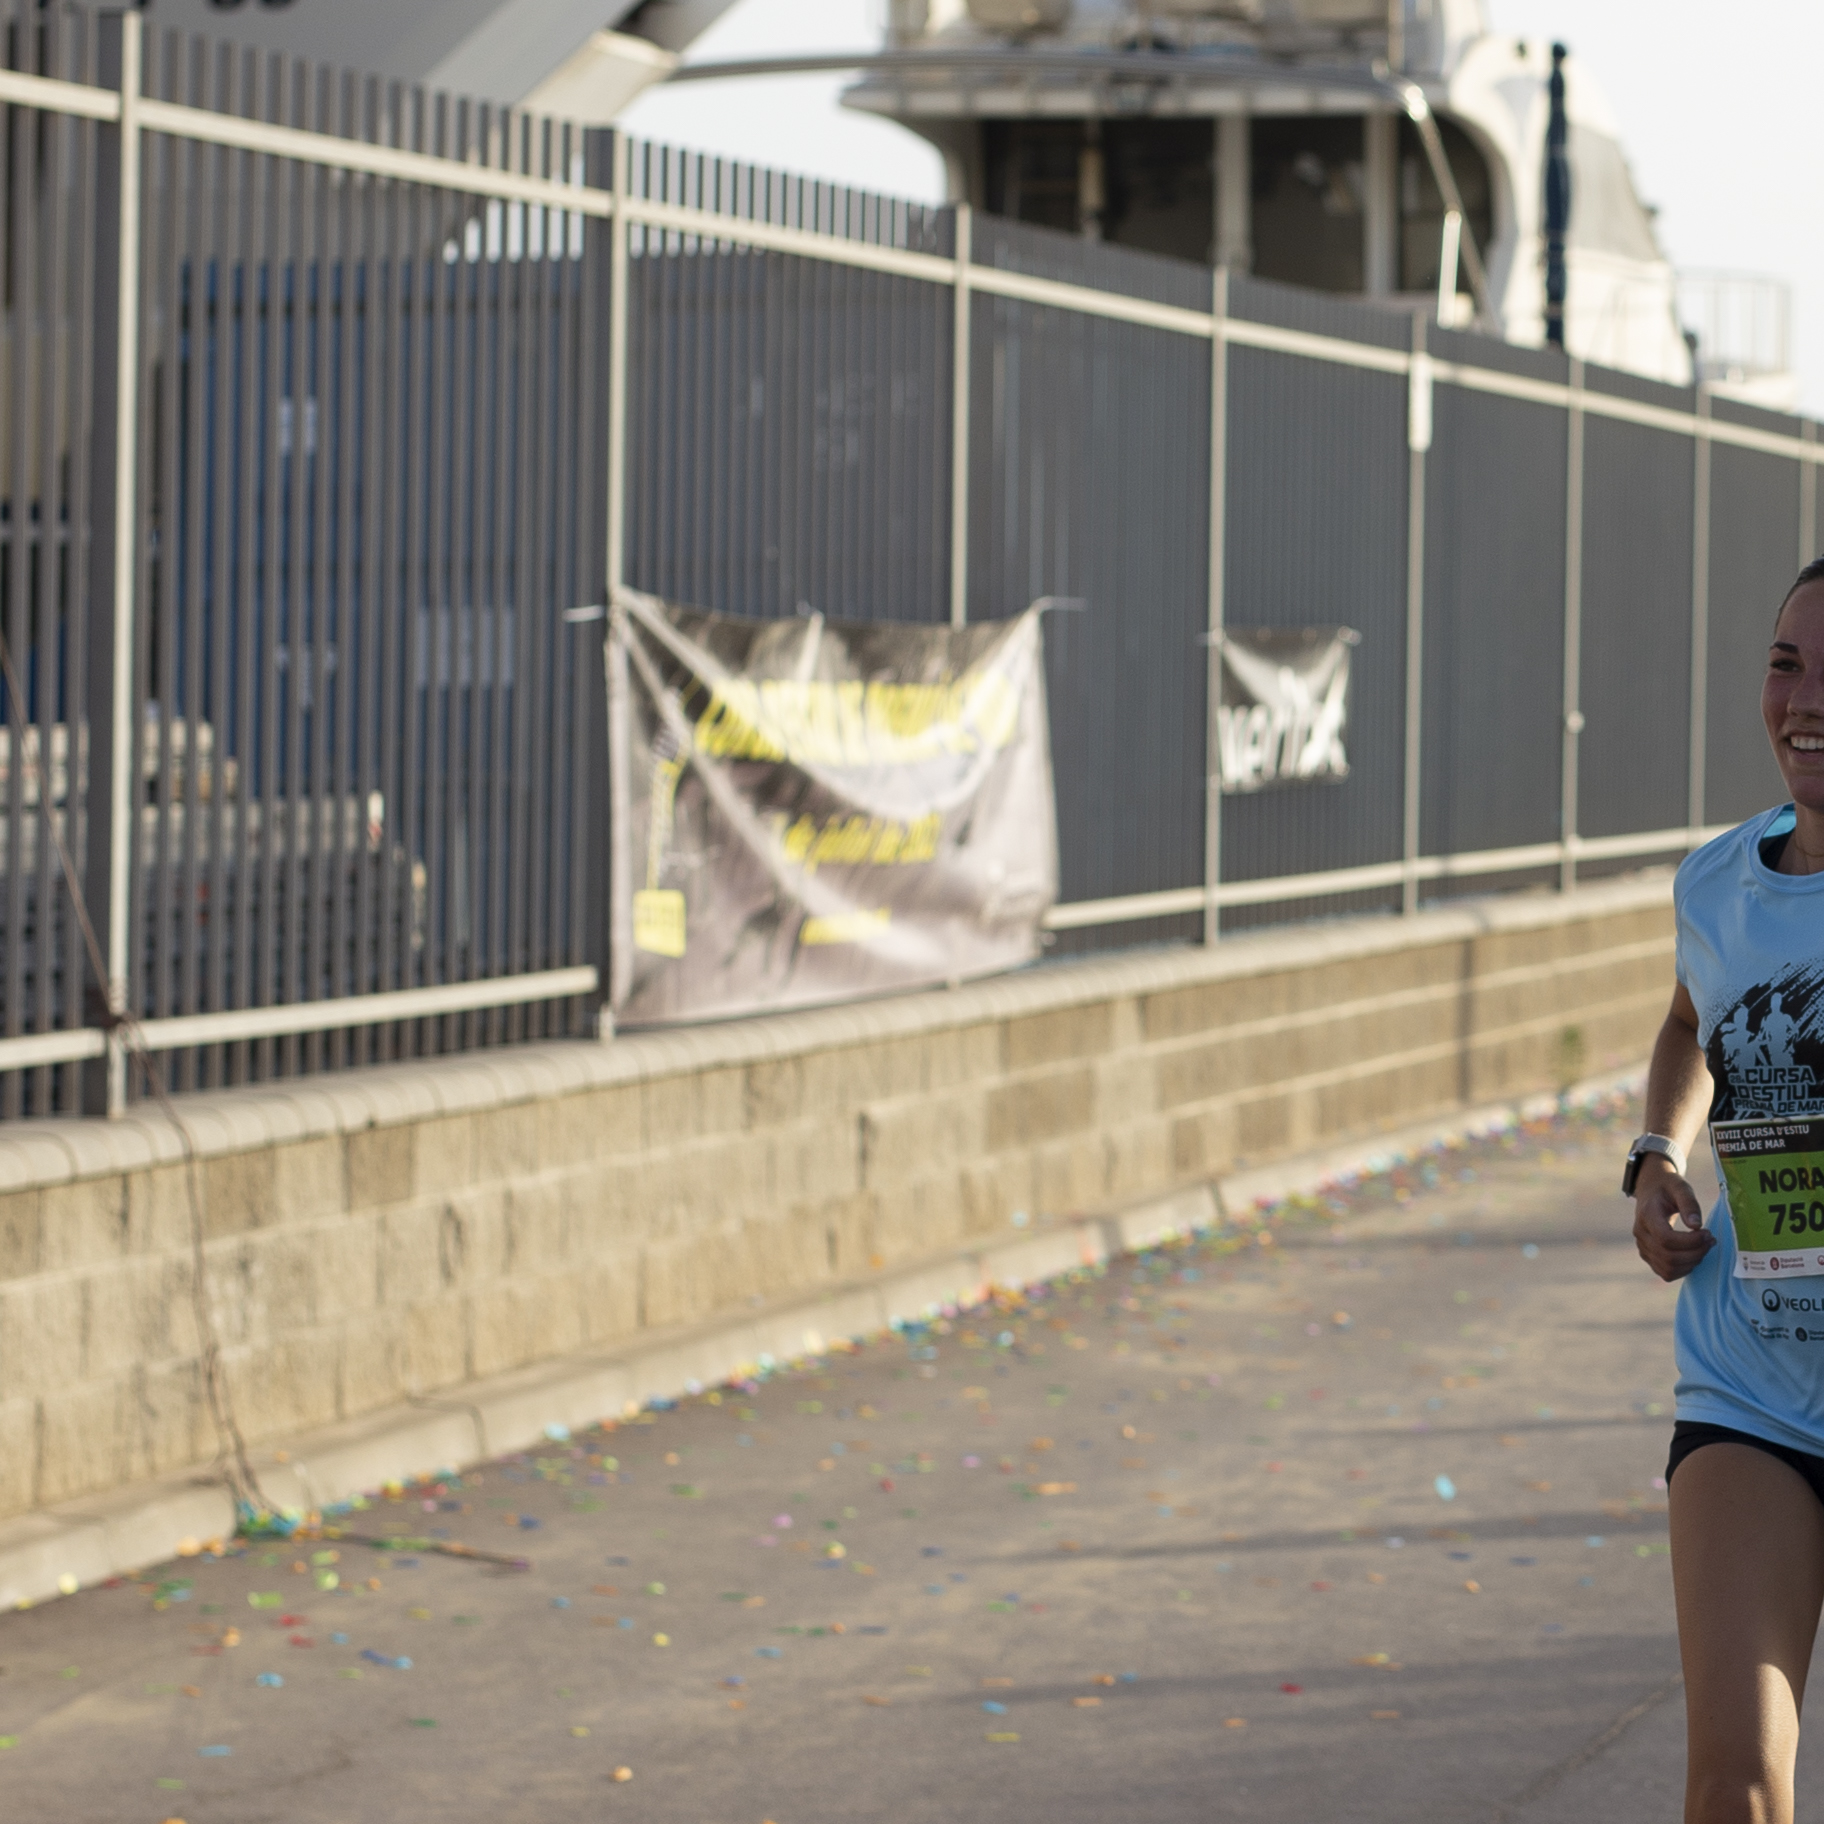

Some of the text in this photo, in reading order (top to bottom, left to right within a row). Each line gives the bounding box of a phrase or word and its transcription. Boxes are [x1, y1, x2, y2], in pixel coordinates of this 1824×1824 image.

[1745, 1067, 1814, 1085] CURSA
[1777, 1100, 1796, 1113] DE
[1715, 1129, 1742, 1141] XXVIII
[1743, 1126, 1775, 1138] CURSA
[1749, 1140, 1763, 1150] DE
[1764, 1138, 1787, 1149] MAR
